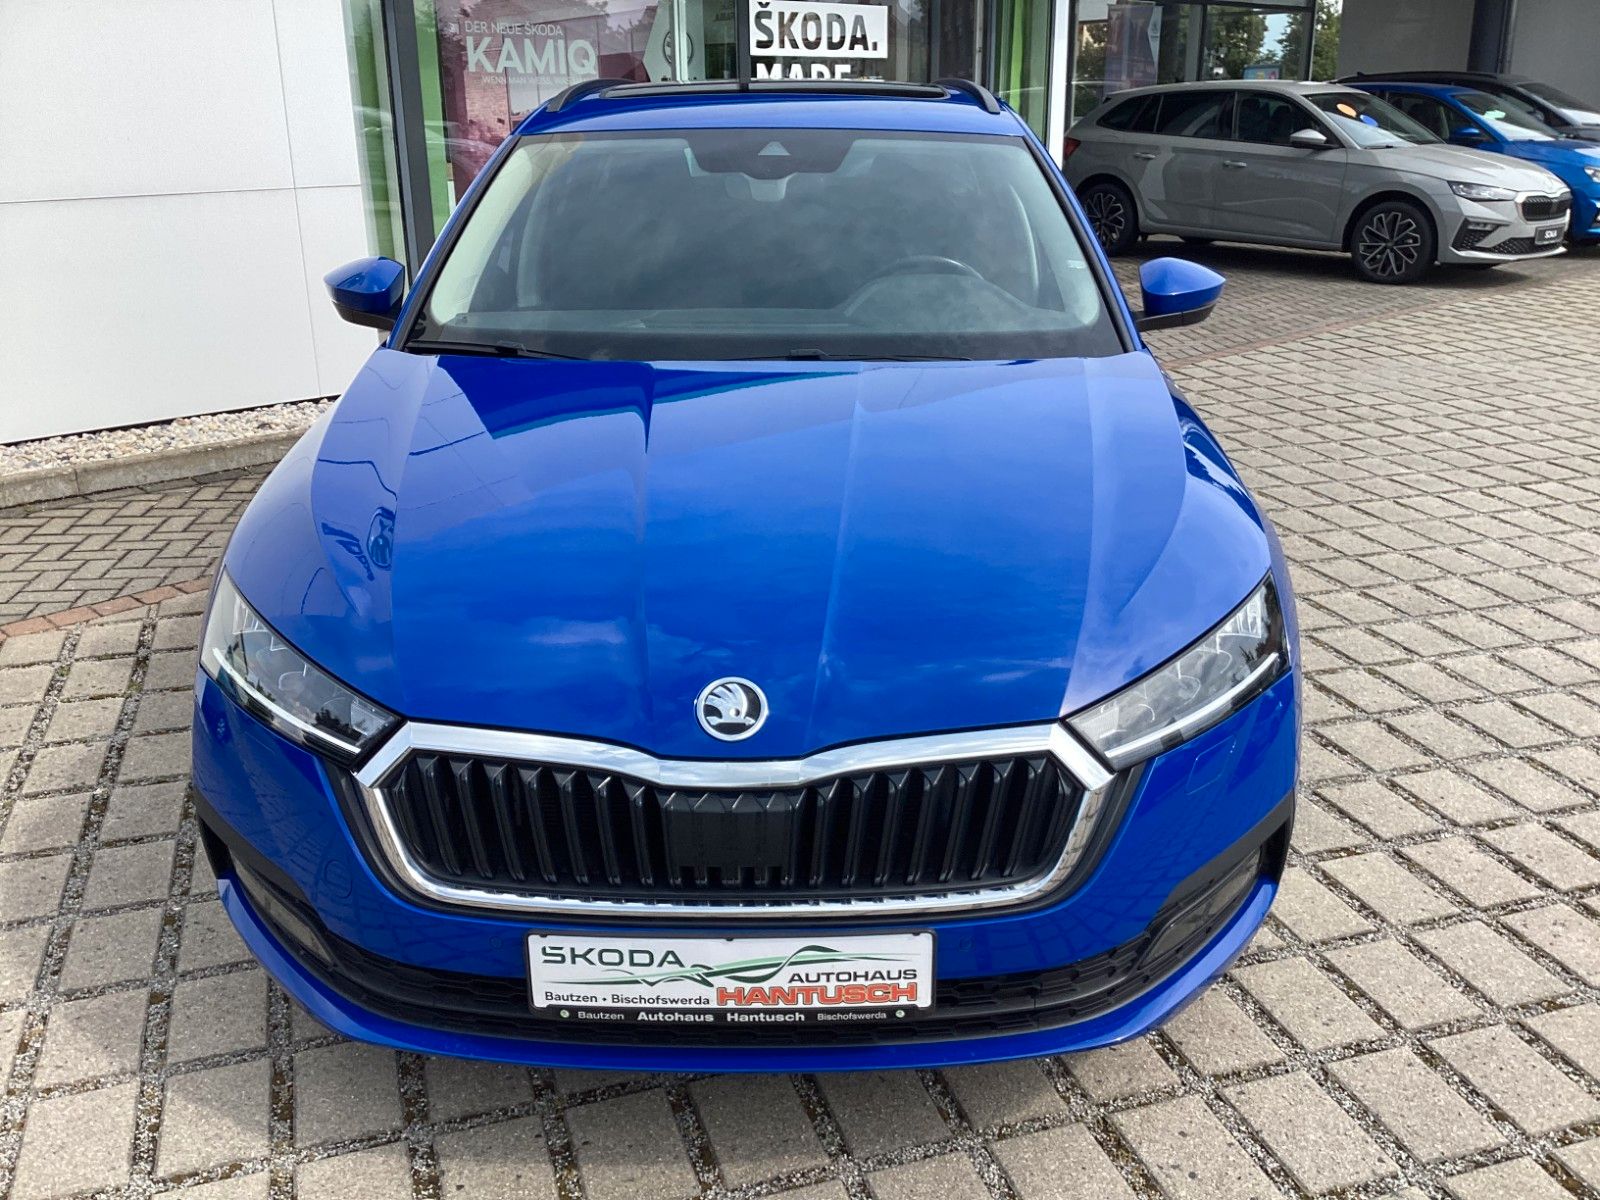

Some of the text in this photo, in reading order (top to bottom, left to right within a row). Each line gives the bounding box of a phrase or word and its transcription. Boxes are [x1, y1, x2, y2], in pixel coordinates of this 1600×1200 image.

[464, 20, 564, 36] DER NEUE ŠKODA
[755, 2, 878, 51] ŠKODA.
[465, 35, 597, 75] KAMIQ
[788, 969, 917, 984] AUTOHAUS
[545, 991, 710, 1006] Bautzen Bischofswerda
[716, 982, 918, 1006] HANTUSCH
[578, 1011, 887, 1022] Bautzen Autohaus Hantusch Bischofswerda
